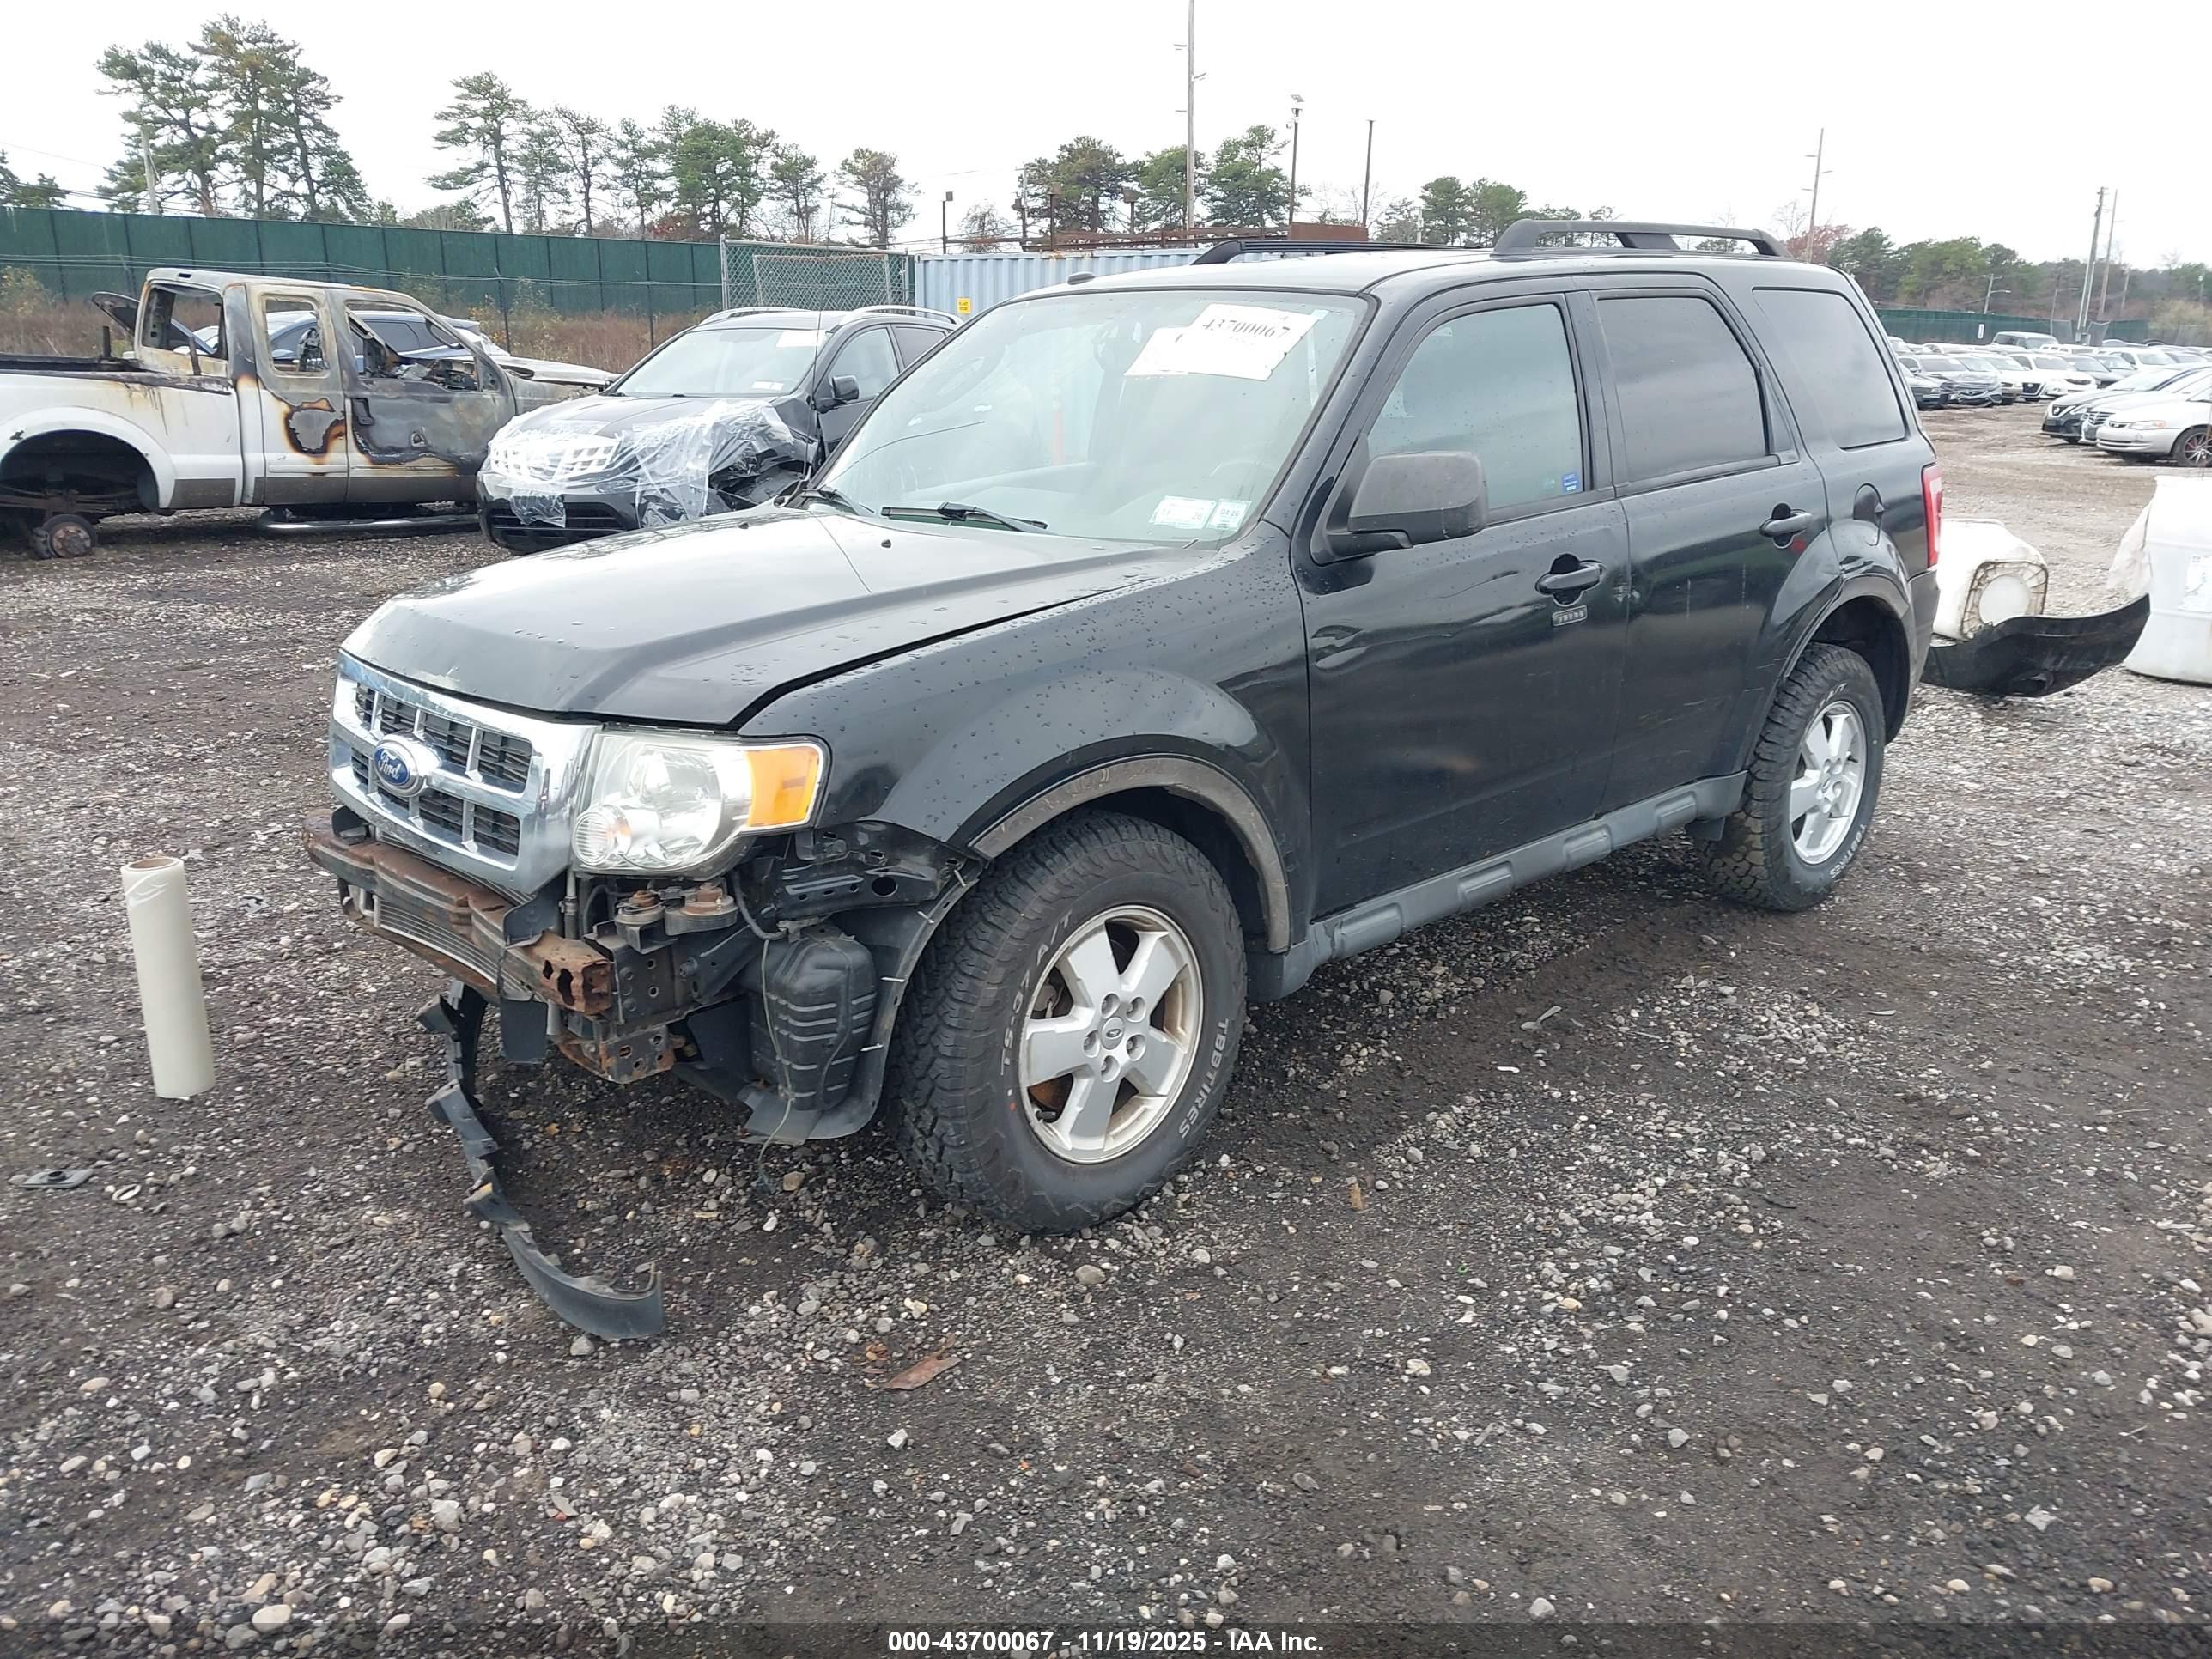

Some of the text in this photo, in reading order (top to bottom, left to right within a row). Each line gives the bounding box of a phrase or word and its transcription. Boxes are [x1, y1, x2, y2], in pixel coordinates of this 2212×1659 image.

[1202, 318, 1291, 339] 43700067
[378, 750, 402, 780] Ford
[1000, 908, 1073, 1076] TS-37 A/T
[1178, 1018, 1230, 1139] TBBTIRES
